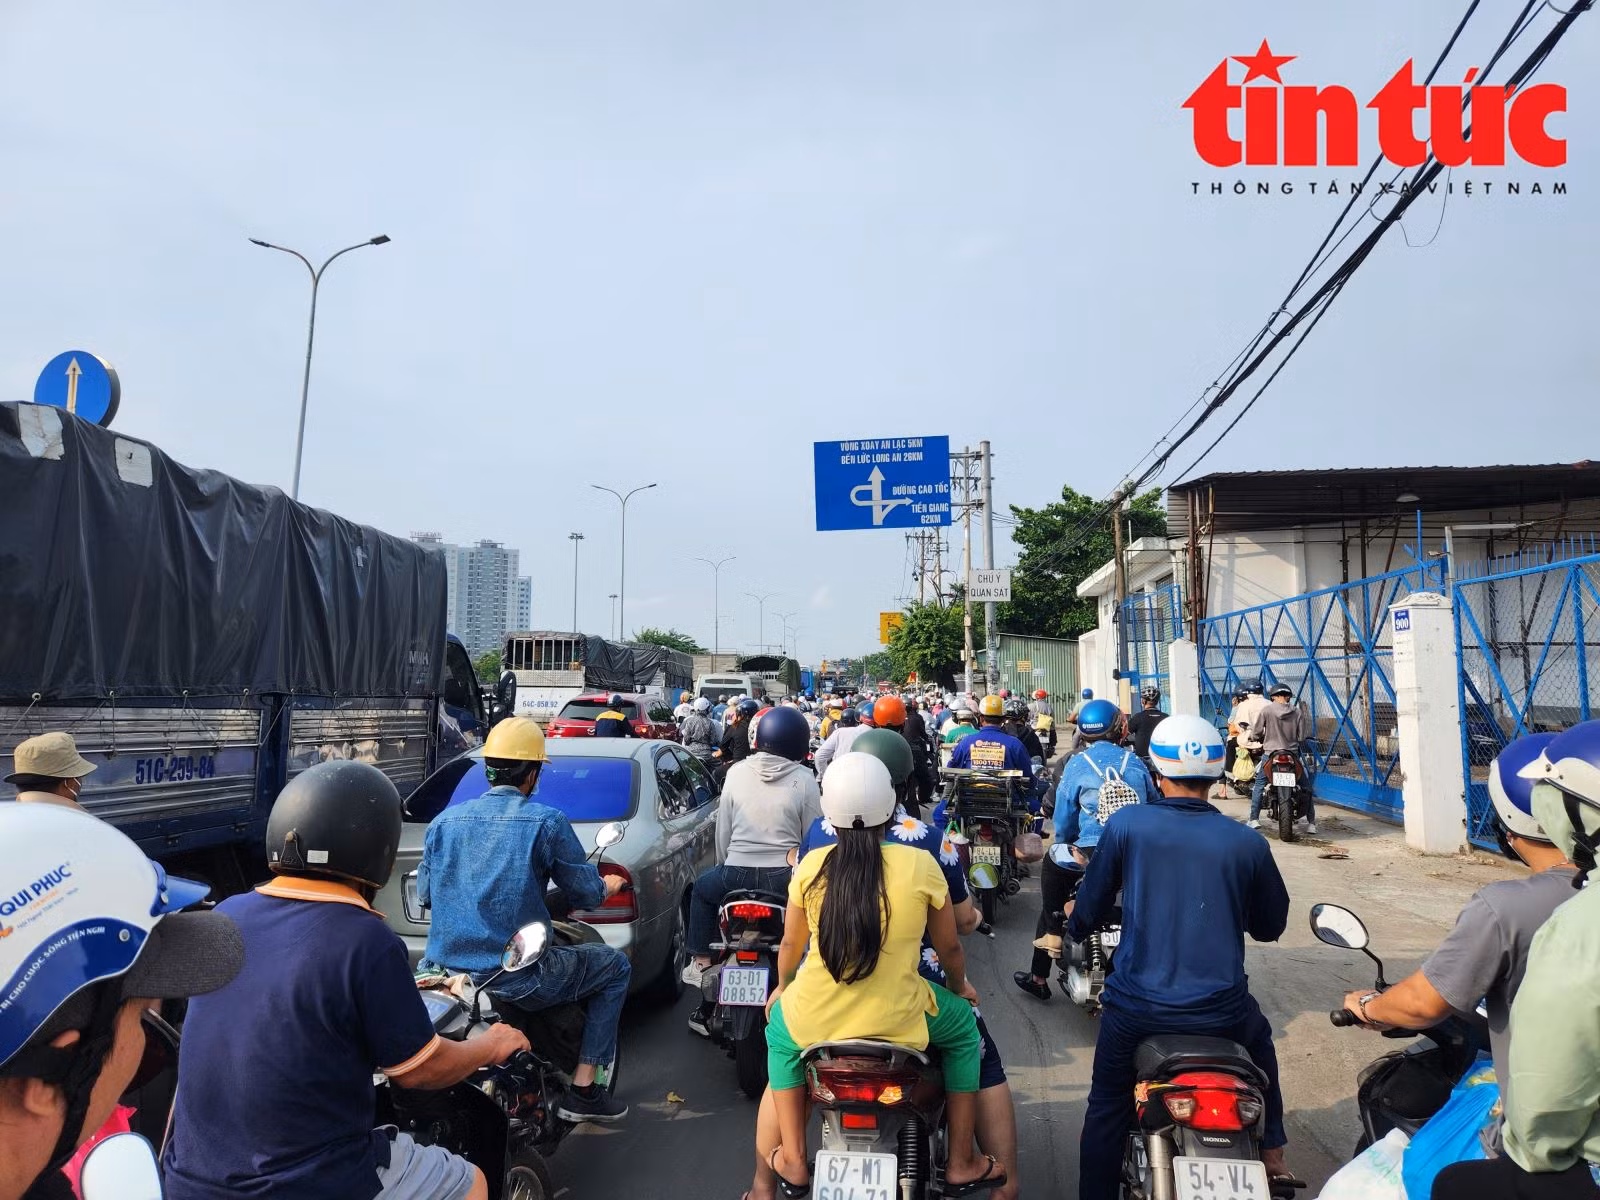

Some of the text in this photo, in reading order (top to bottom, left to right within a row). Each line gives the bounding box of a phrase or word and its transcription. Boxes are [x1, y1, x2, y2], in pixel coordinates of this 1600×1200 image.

[881, 440, 891, 450] AN
[892, 439, 906, 451] LẠC
[907, 438, 923, 449] 5KM
[841, 452, 856, 464] BẾN
[872, 453, 890, 463] LONG
[918, 485, 933, 494] CAO
[934, 481, 949, 494] TỐC
[928, 503, 949, 512] GIANG
[920, 514, 941, 524] 62KM
[977, 571, 994, 584] CHÚ
[970, 586, 1008, 597] QUAN SÁT
[1396, 618, 1409, 629] 900
[135, 755, 215, 785] 51C-259-84
[0, 888, 33, 916] QUI
[728, 970, 761, 986] 63-D1
[722, 986, 765, 1003] 088.52
[828, 1156, 882, 1185] 67-M1
[1188, 1162, 1254, 1193] 54-V4
